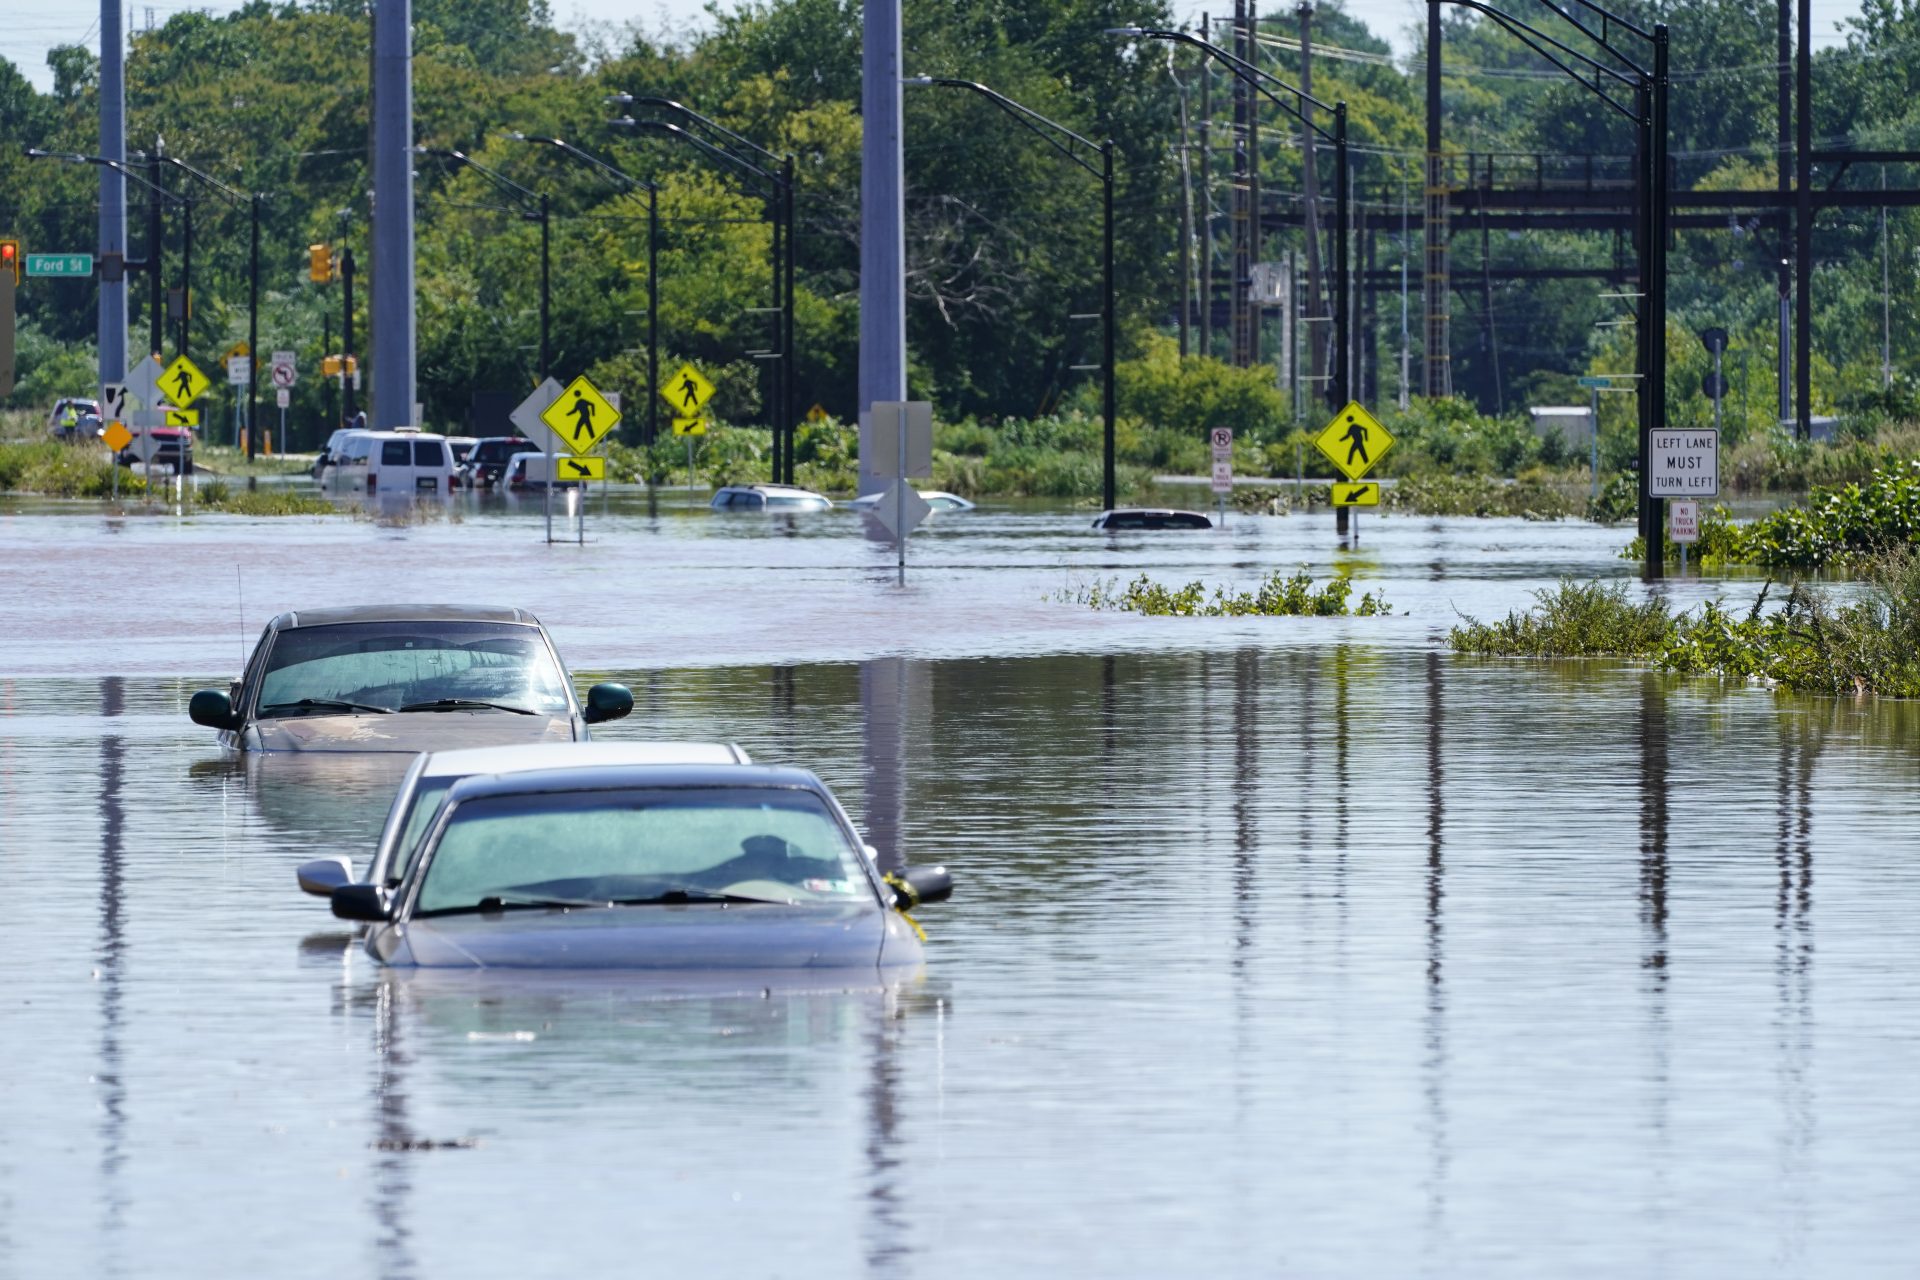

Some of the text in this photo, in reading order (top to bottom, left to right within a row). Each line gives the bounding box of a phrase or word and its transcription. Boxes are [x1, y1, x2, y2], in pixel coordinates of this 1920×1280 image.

[35, 258, 83, 272] Ford St
[1657, 438, 1713, 449] LEFT LANE
[1667, 456, 1702, 469] MUST
[1656, 477, 1713, 488] TURN LEFT
[1680, 507, 1689, 515] NO
[1675, 517, 1694, 526] TRUCK
[1672, 528, 1696, 536] PARKING
